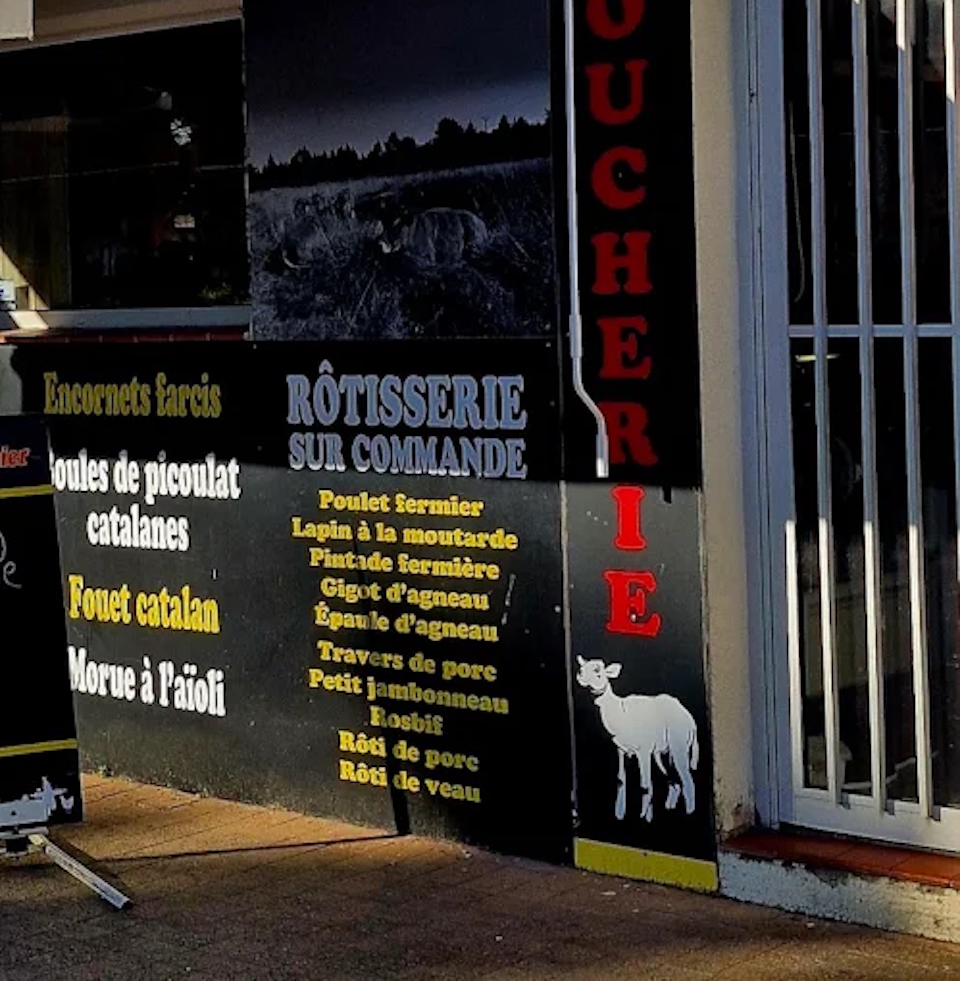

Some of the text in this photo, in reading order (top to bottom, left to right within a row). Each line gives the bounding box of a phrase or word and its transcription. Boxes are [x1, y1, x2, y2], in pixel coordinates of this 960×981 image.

[43, 371, 222, 418] Encornets farcis
[286, 359, 528, 430] RÔTISSERIE
[113, 449, 140, 494] de
[144, 449, 241, 505] picoulat
[288, 432, 528, 480] SUR COMMANDE
[318, 489, 484, 517] Poulet fermier
[87, 504, 190, 552] catalanes
[292, 517, 519, 551] Lapin à la moutarde
[309, 546, 501, 580] Pintade fermière
[68, 575, 220, 634] Fouet catalan
[320, 577, 490, 610] Gigot d'agneau
[314, 601, 500, 642] Épaule d'agneau
[68, 645, 136, 701] Morue
[141, 656, 154, 704] à
[317, 639, 498, 682] Travers de porc
[309, 668, 510, 714] Petit jambonneau
[369, 705, 444, 736] Rosbif
[338, 730, 480, 772] Rôti de porc
[339, 759, 482, 803] Rôti de veau
